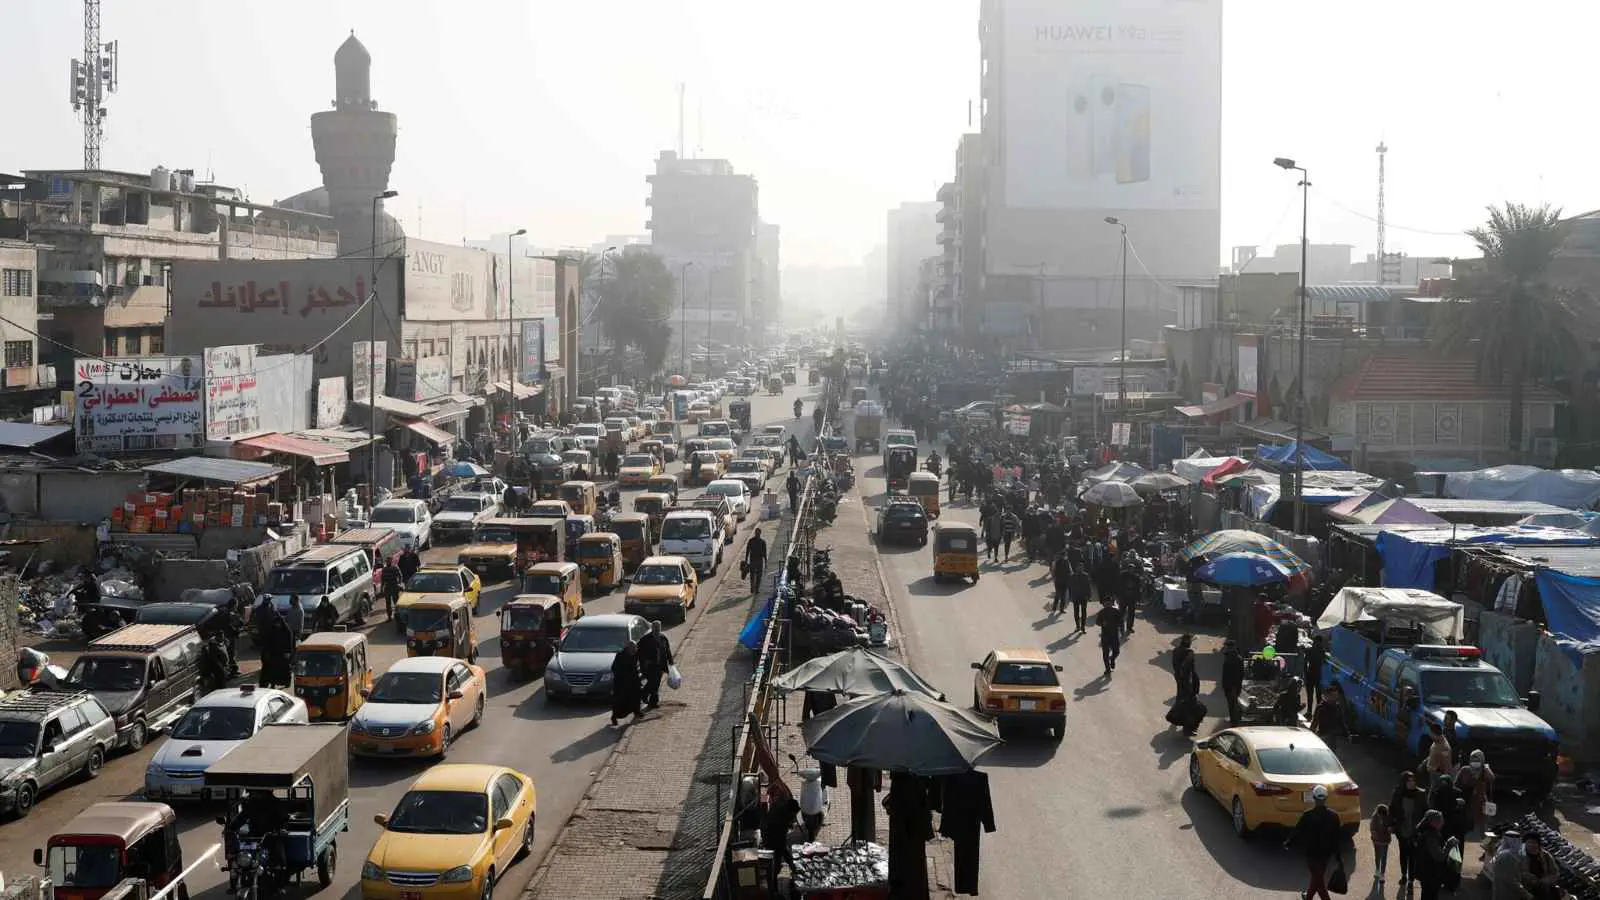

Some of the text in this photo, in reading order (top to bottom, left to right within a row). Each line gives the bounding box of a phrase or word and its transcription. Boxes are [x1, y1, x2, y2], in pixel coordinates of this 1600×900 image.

[1035, 25, 1112, 41] HUAWEI
[198, 280, 289, 315] إعلانك
[120, 361, 162, 381] محلات
[79, 381, 95, 398] 2
